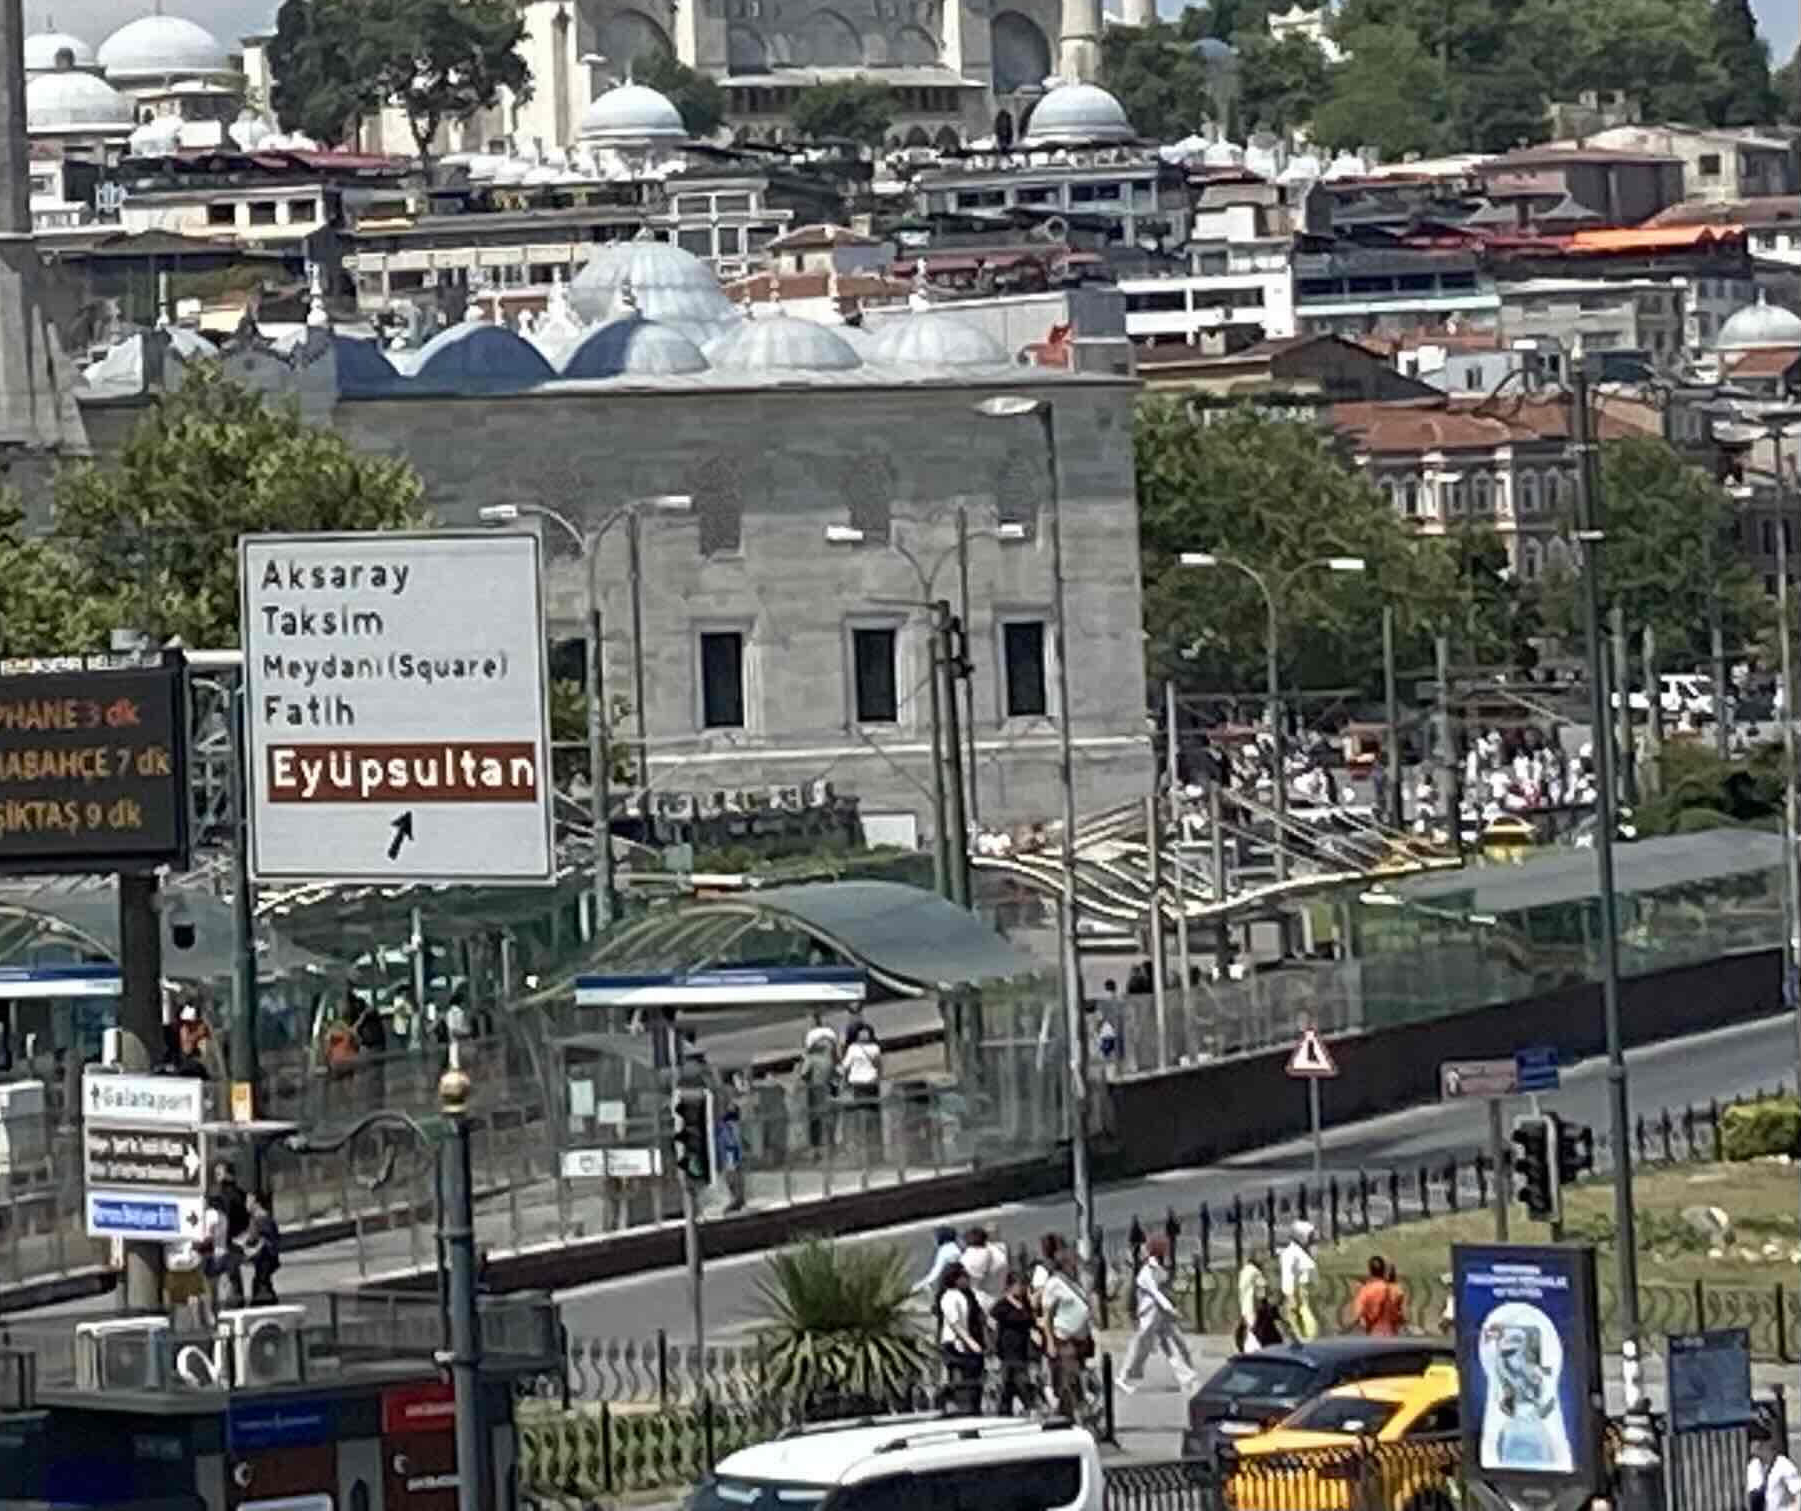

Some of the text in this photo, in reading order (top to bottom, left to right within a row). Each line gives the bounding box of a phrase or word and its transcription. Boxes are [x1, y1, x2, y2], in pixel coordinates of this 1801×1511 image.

[261, 560, 409, 595] Aksaray
[261, 605, 384, 636] Taksim
[105, 696, 141, 729] dk
[264, 695, 355, 726] Fatih
[115, 748, 133, 778] 7
[134, 745, 172, 777] dk
[272, 748, 536, 799] Eyüpsultan
[85, 803, 103, 830] 9
[106, 798, 142, 830] dk
